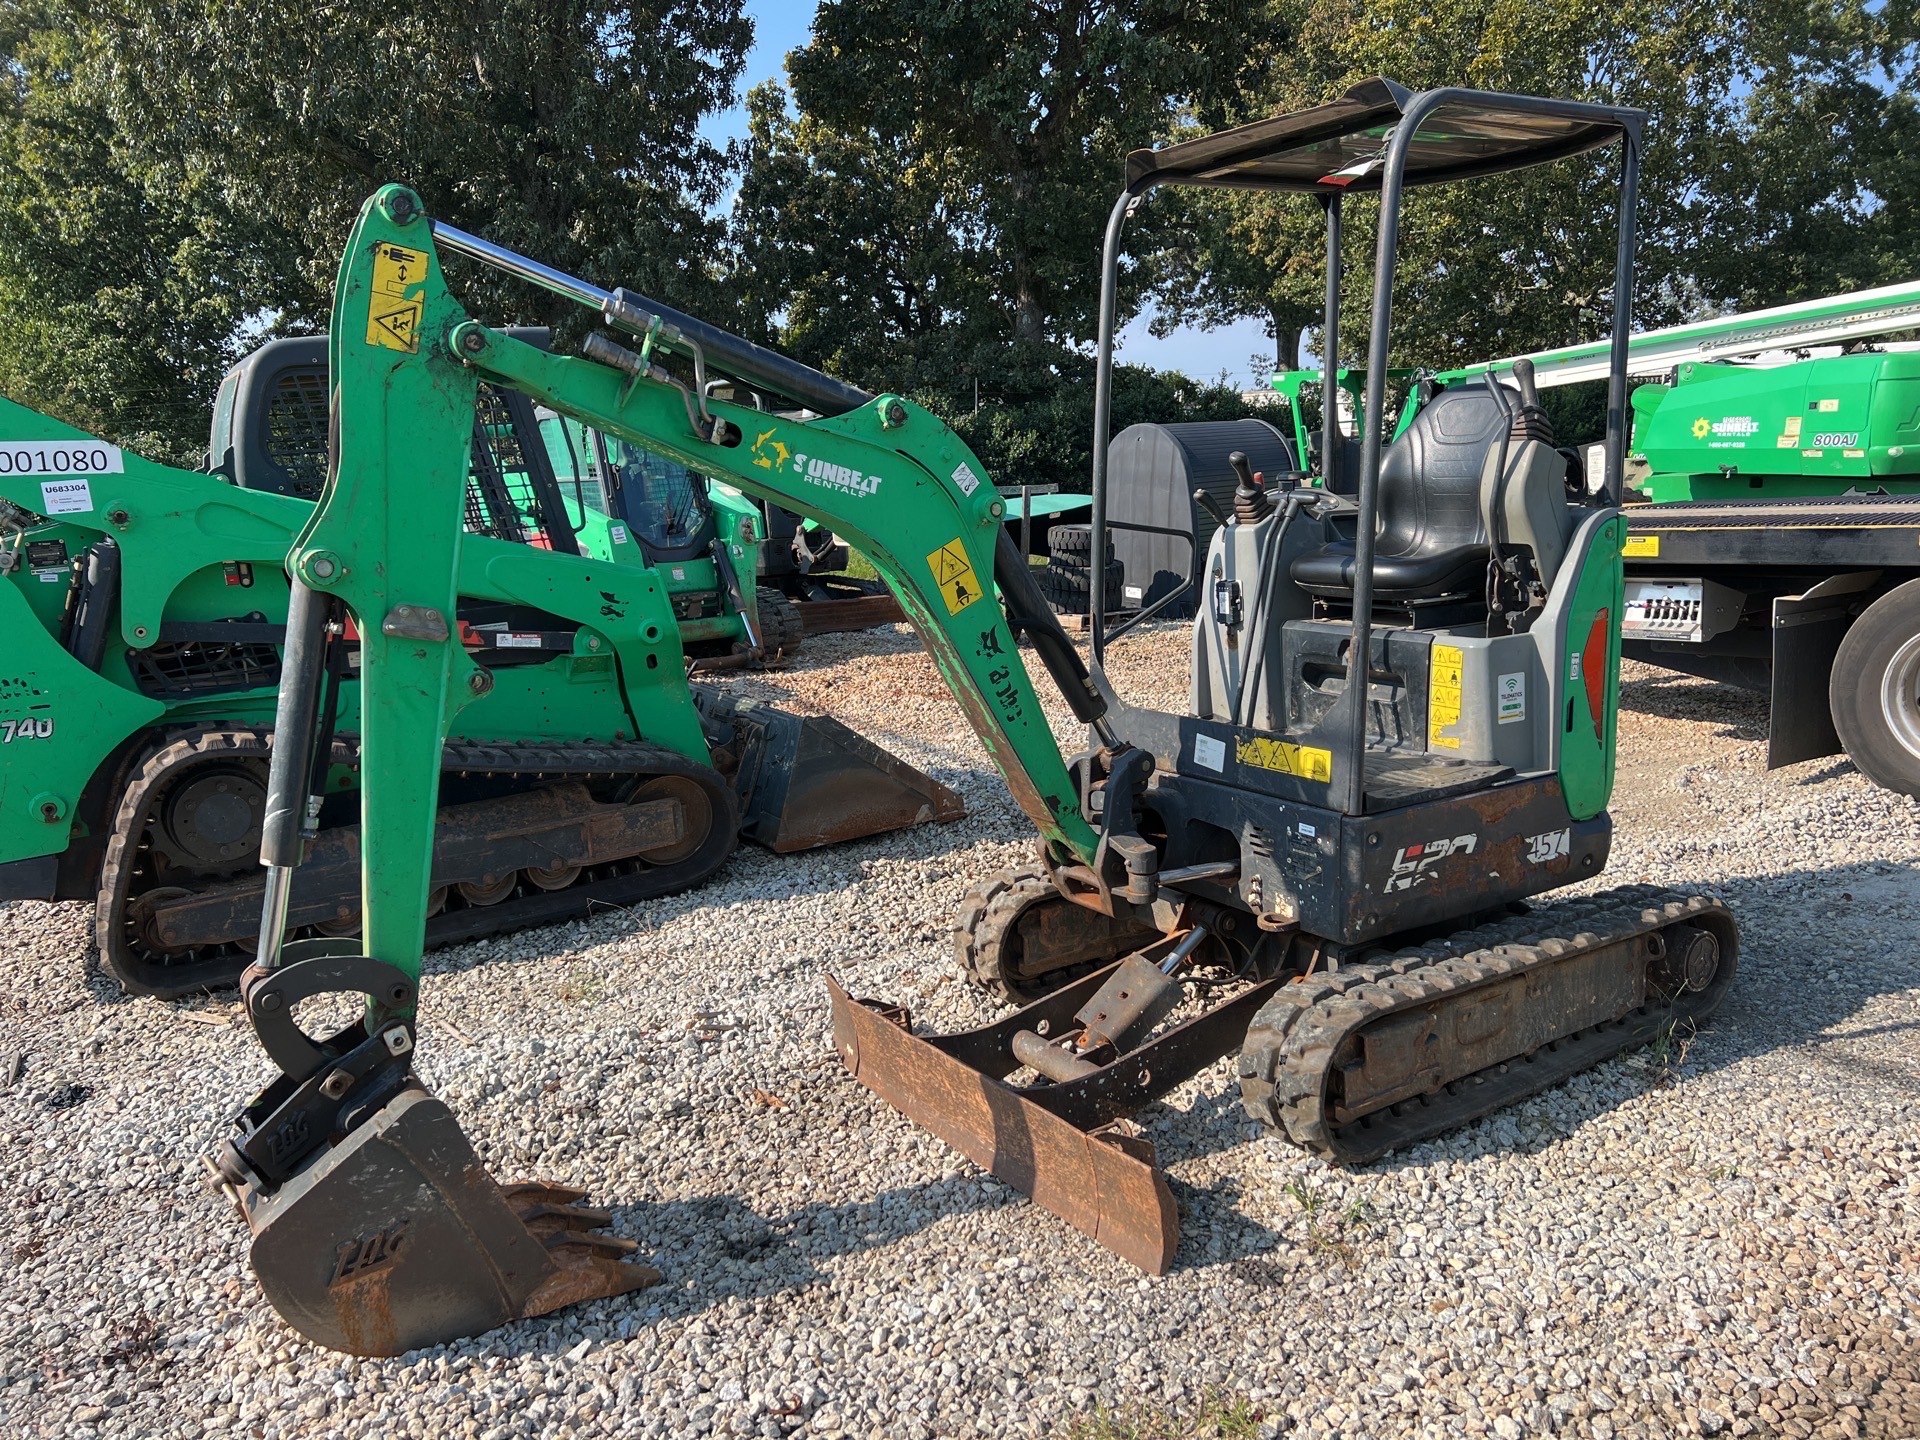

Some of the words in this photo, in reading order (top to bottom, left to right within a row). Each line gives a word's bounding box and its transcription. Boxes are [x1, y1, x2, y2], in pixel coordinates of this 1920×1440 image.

[1711, 422, 1759, 433] SUNBELT
[1813, 433, 1858, 448] 800AJ
[0, 450, 107, 473] 001080
[793, 453, 882, 494] SUNBELT
[45, 484, 86, 494] U683304
[804, 475, 867, 498] RENTALS
[1501, 691, 1523, 700] TELEMATICS
[2, 717, 54, 744] 740
[1528, 830, 1563, 858] 457
